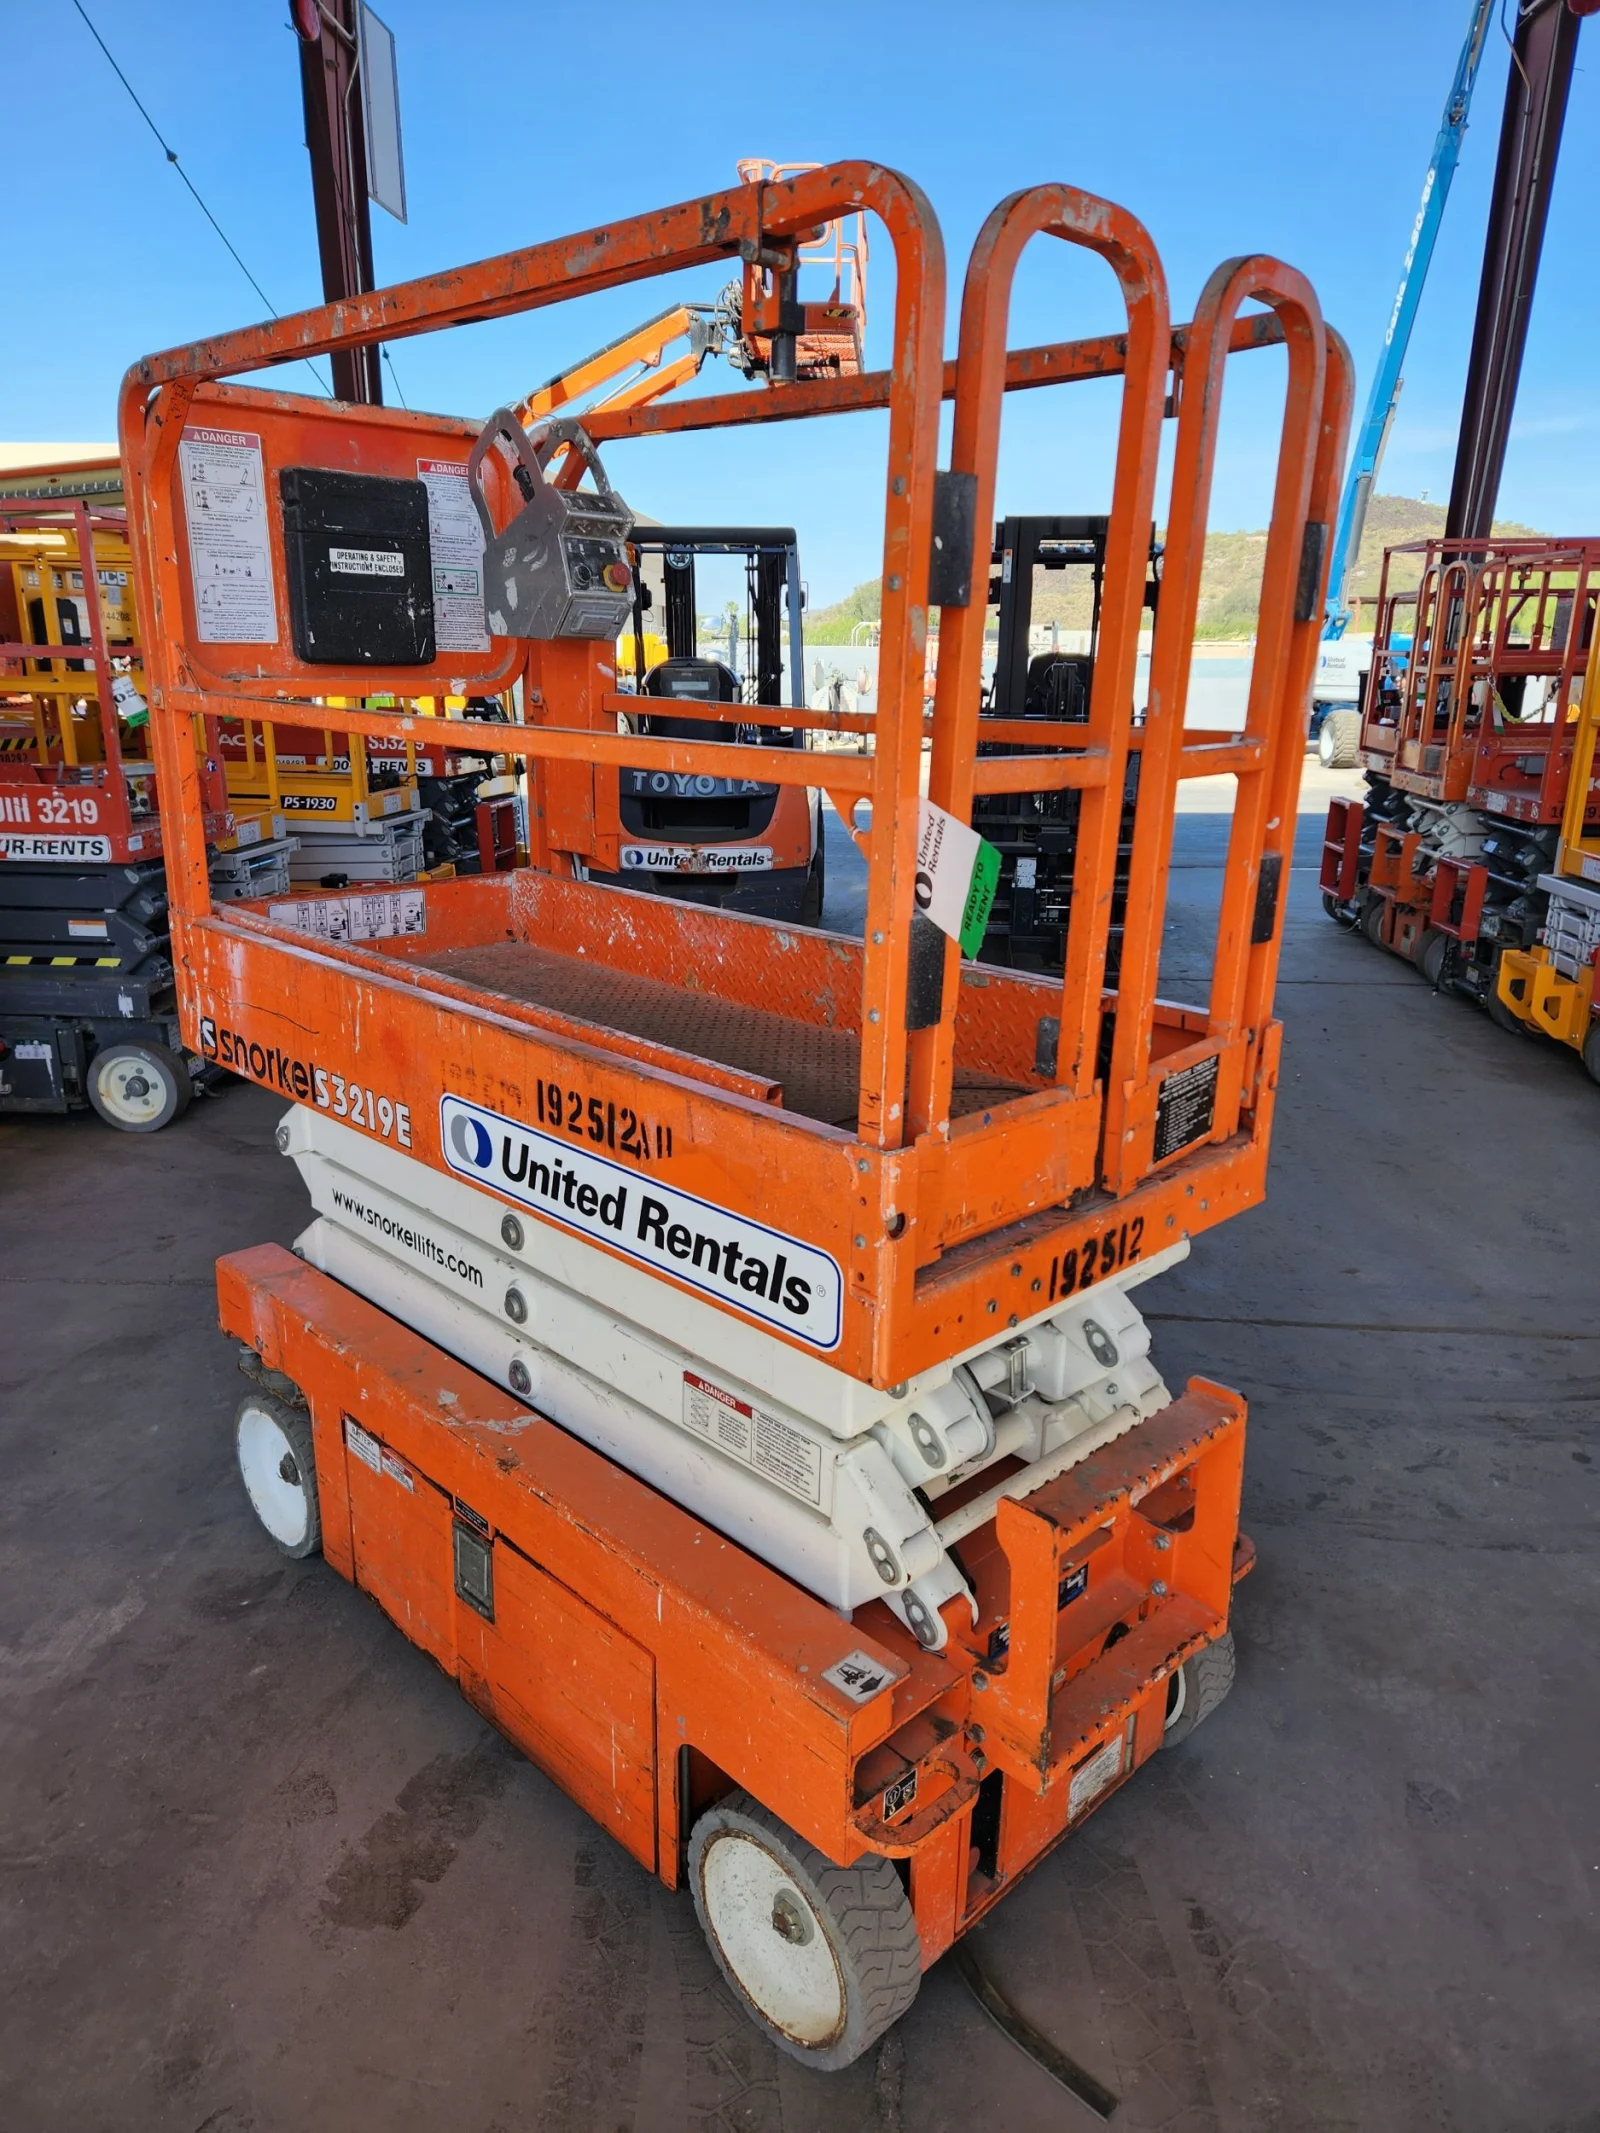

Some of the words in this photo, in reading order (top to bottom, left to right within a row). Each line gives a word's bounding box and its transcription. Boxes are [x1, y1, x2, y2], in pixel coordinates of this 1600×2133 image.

[201, 431, 246, 446] DANGER
[331, 561, 373, 572] INSTRUCTIONS
[374, 563, 404, 574] ENCLOSED
[336, 551, 369, 562] OPERATING
[370, 553, 375, 562] &
[376, 554, 397, 563] SAFETY
[37, 797, 99, 824] 3219
[283, 796, 336, 810] PS-1930
[917, 810, 935, 868] United
[928, 817, 946, 875] Rentals
[647, 852, 702, 866] Unite
[705, 852, 765, 867] Rentals
[964, 884, 981, 932] READY
[975, 862, 984, 882] TO
[976, 884, 991, 924] RENT
[219, 1028, 318, 1104] snorkel
[314, 1067, 413, 1150] S3219E
[332, 1187, 484, 1289] www.snorkellifts.com
[502, 1136, 628, 1232] United
[637, 1194, 812, 1316] Rentals
[1049, 1216, 1145, 1302] 192512
[703, 1384, 737, 1409] DANGER
